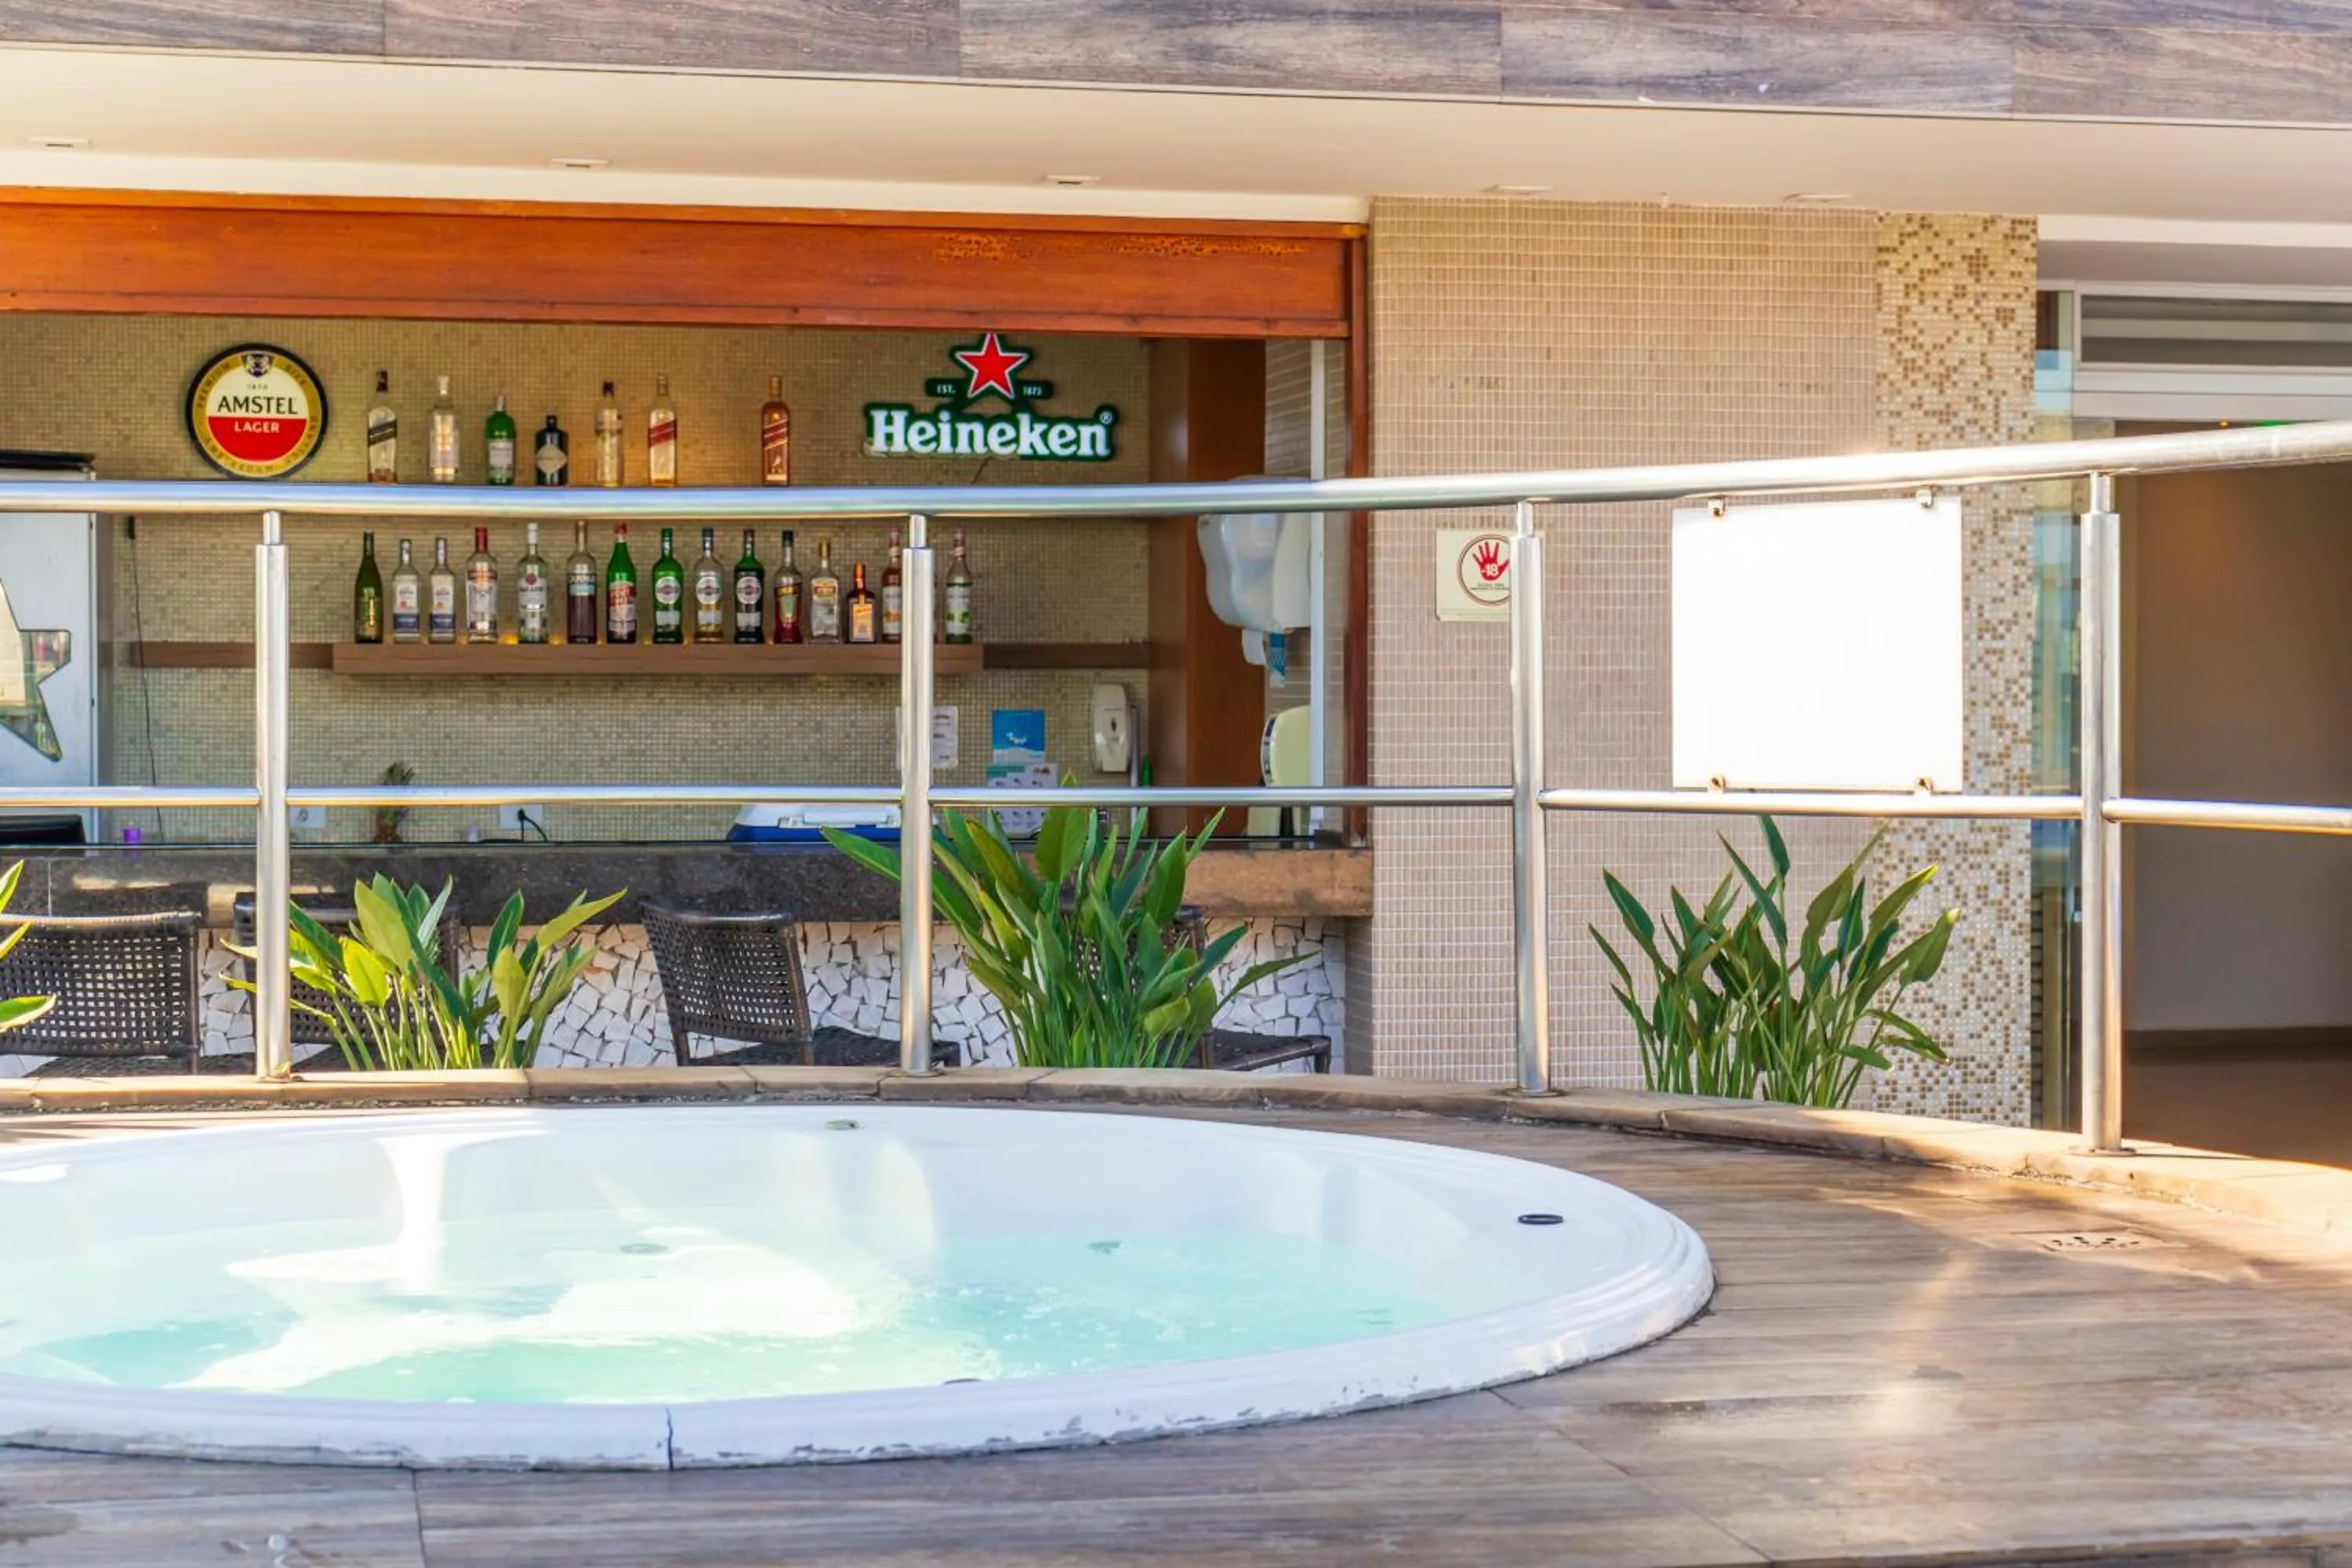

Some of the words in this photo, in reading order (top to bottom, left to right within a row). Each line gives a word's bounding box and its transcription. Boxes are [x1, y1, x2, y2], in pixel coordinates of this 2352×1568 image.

[937, 383, 956, 394] EST.
[217, 395, 298, 415] AMSTEL
[234, 420, 280, 434] LAGER
